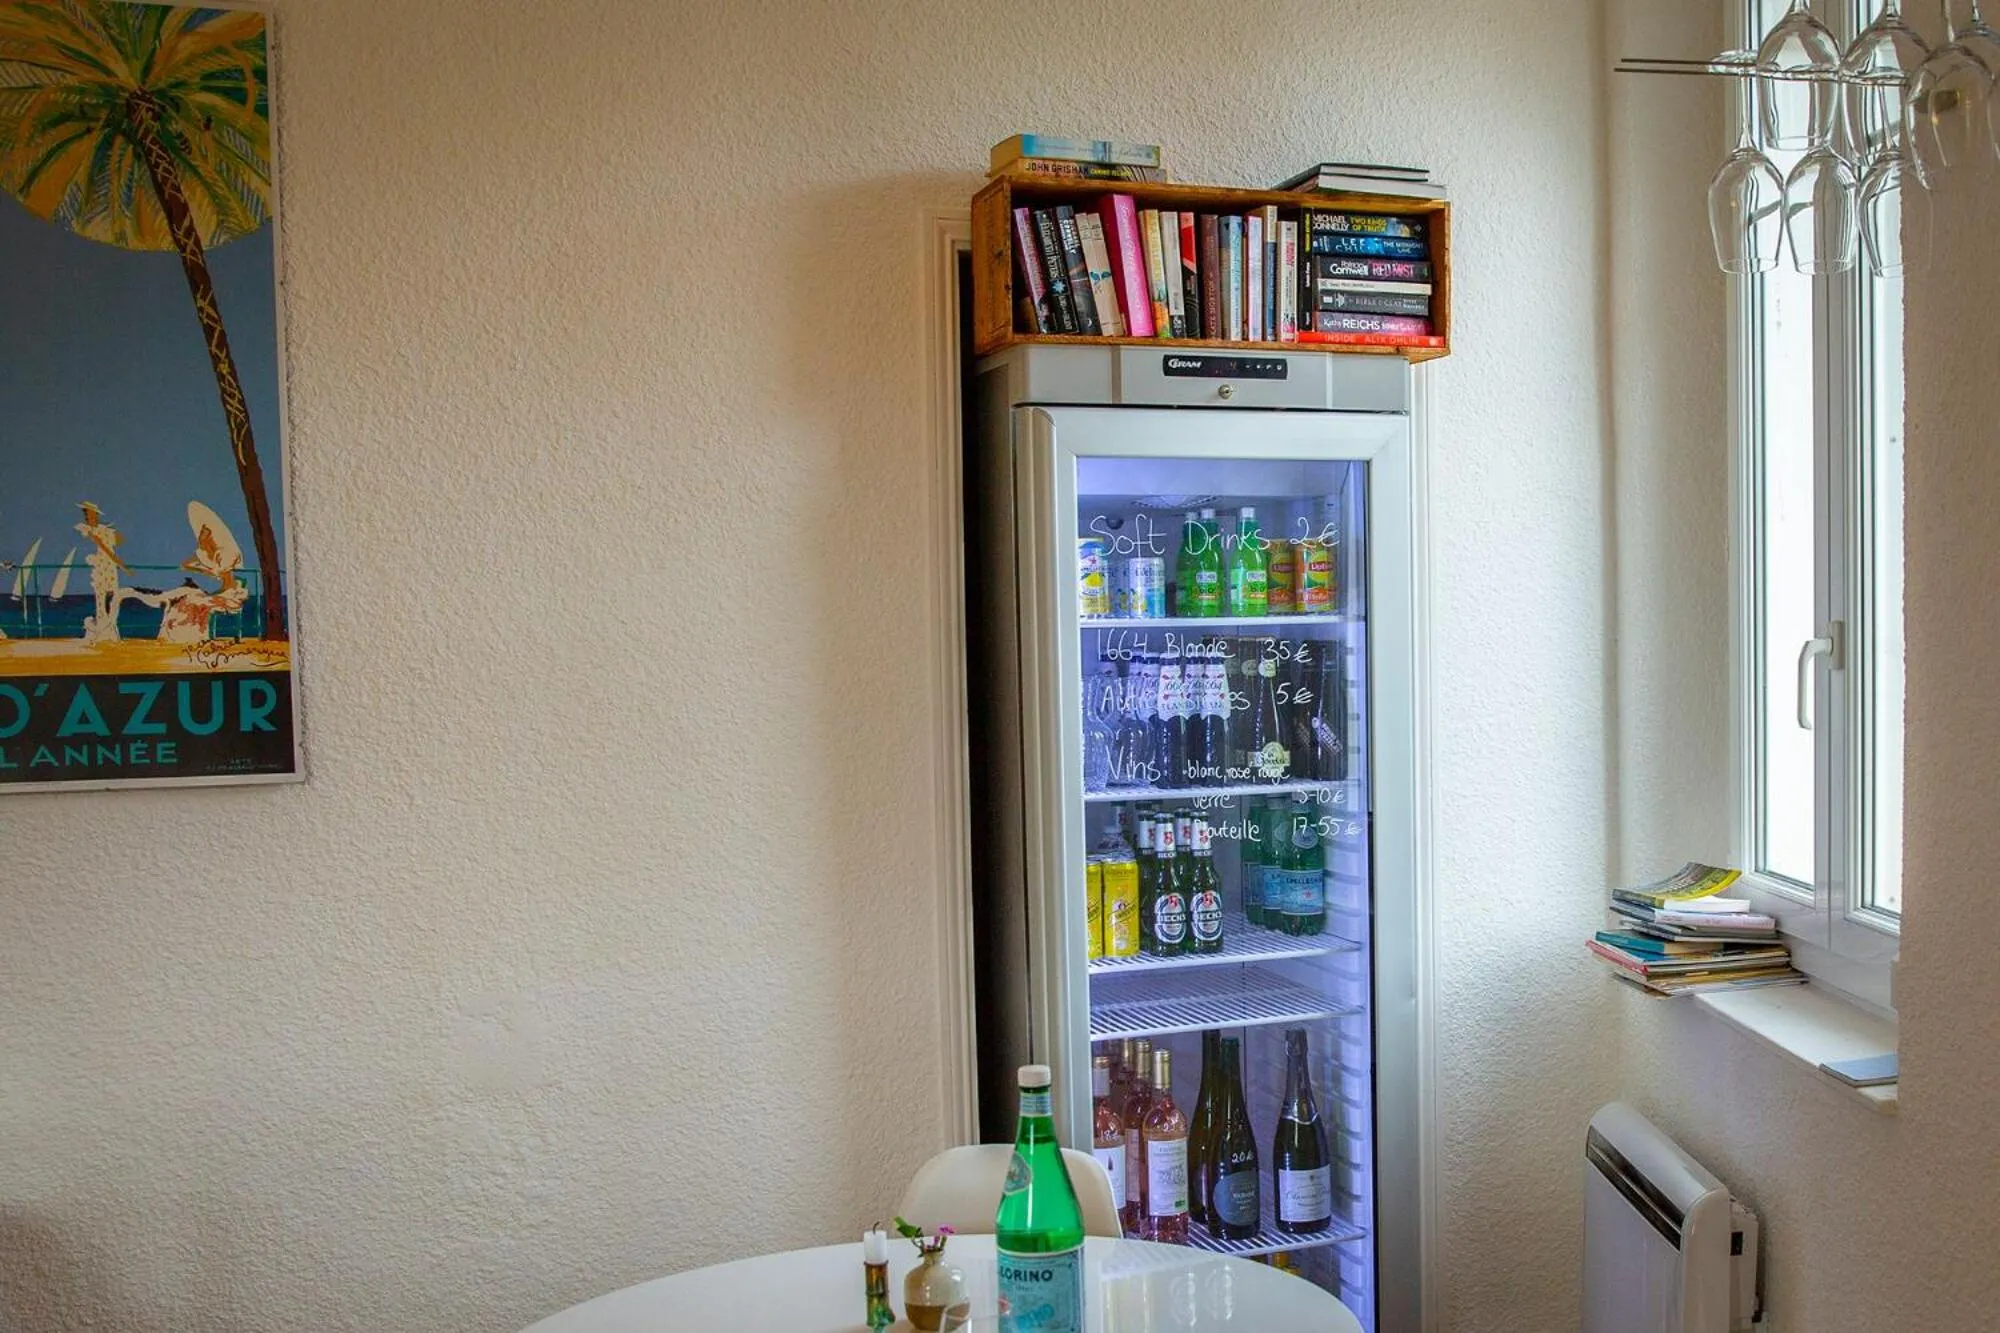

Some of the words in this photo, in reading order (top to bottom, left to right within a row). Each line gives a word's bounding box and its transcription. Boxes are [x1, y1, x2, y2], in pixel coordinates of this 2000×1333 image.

[1025, 162, 1050, 172] JOHN
[1051, 163, 1089, 174] GRISHAM
[1329, 264, 1368, 276] Cornwell
[1343, 320, 1380, 330] REICHS
[1090, 514, 1168, 562] Soft
[1184, 517, 1270, 555] Drinks
[1098, 628, 1149, 660] 1664
[1164, 632, 1236, 658] Blonde
[1105, 745, 1161, 782] Vins
